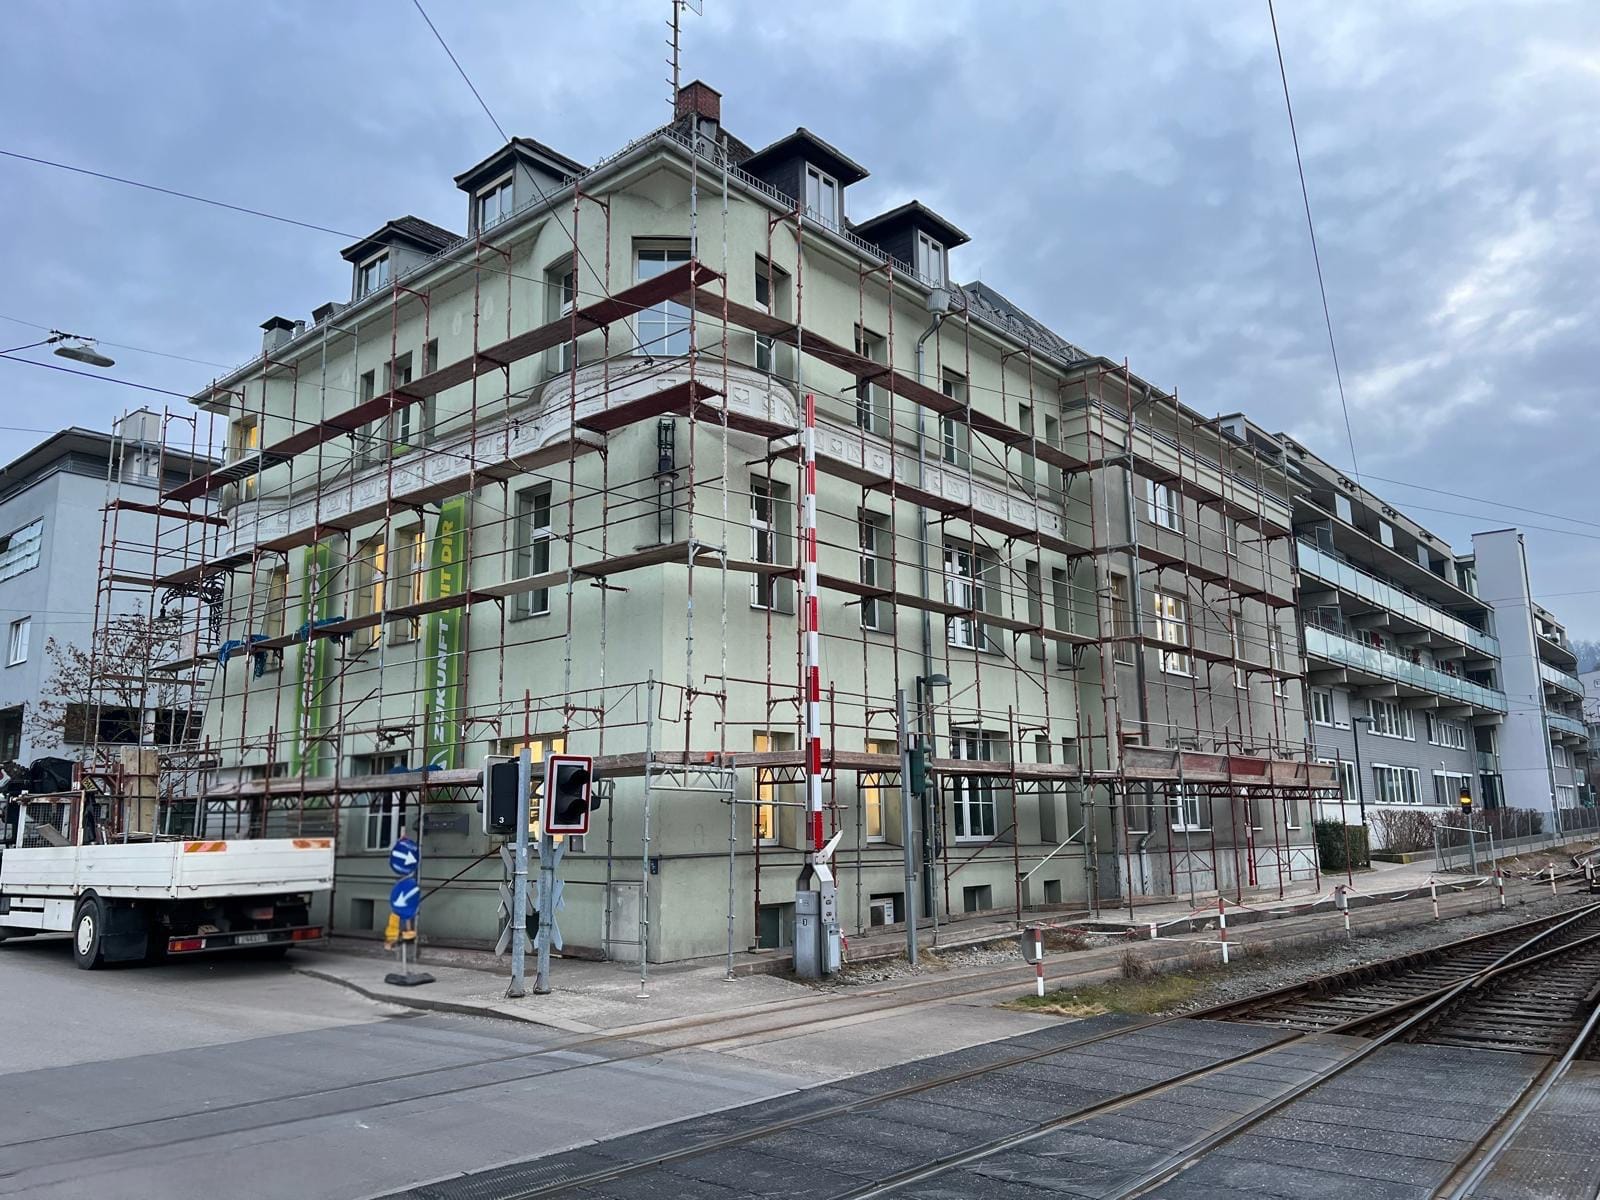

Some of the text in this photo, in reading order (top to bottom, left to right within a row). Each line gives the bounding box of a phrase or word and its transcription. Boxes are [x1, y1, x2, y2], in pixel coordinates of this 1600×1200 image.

[441, 520, 453, 563] DIR
[434, 618, 449, 742] ZUKUNFT
[498, 816, 505, 824] 3
